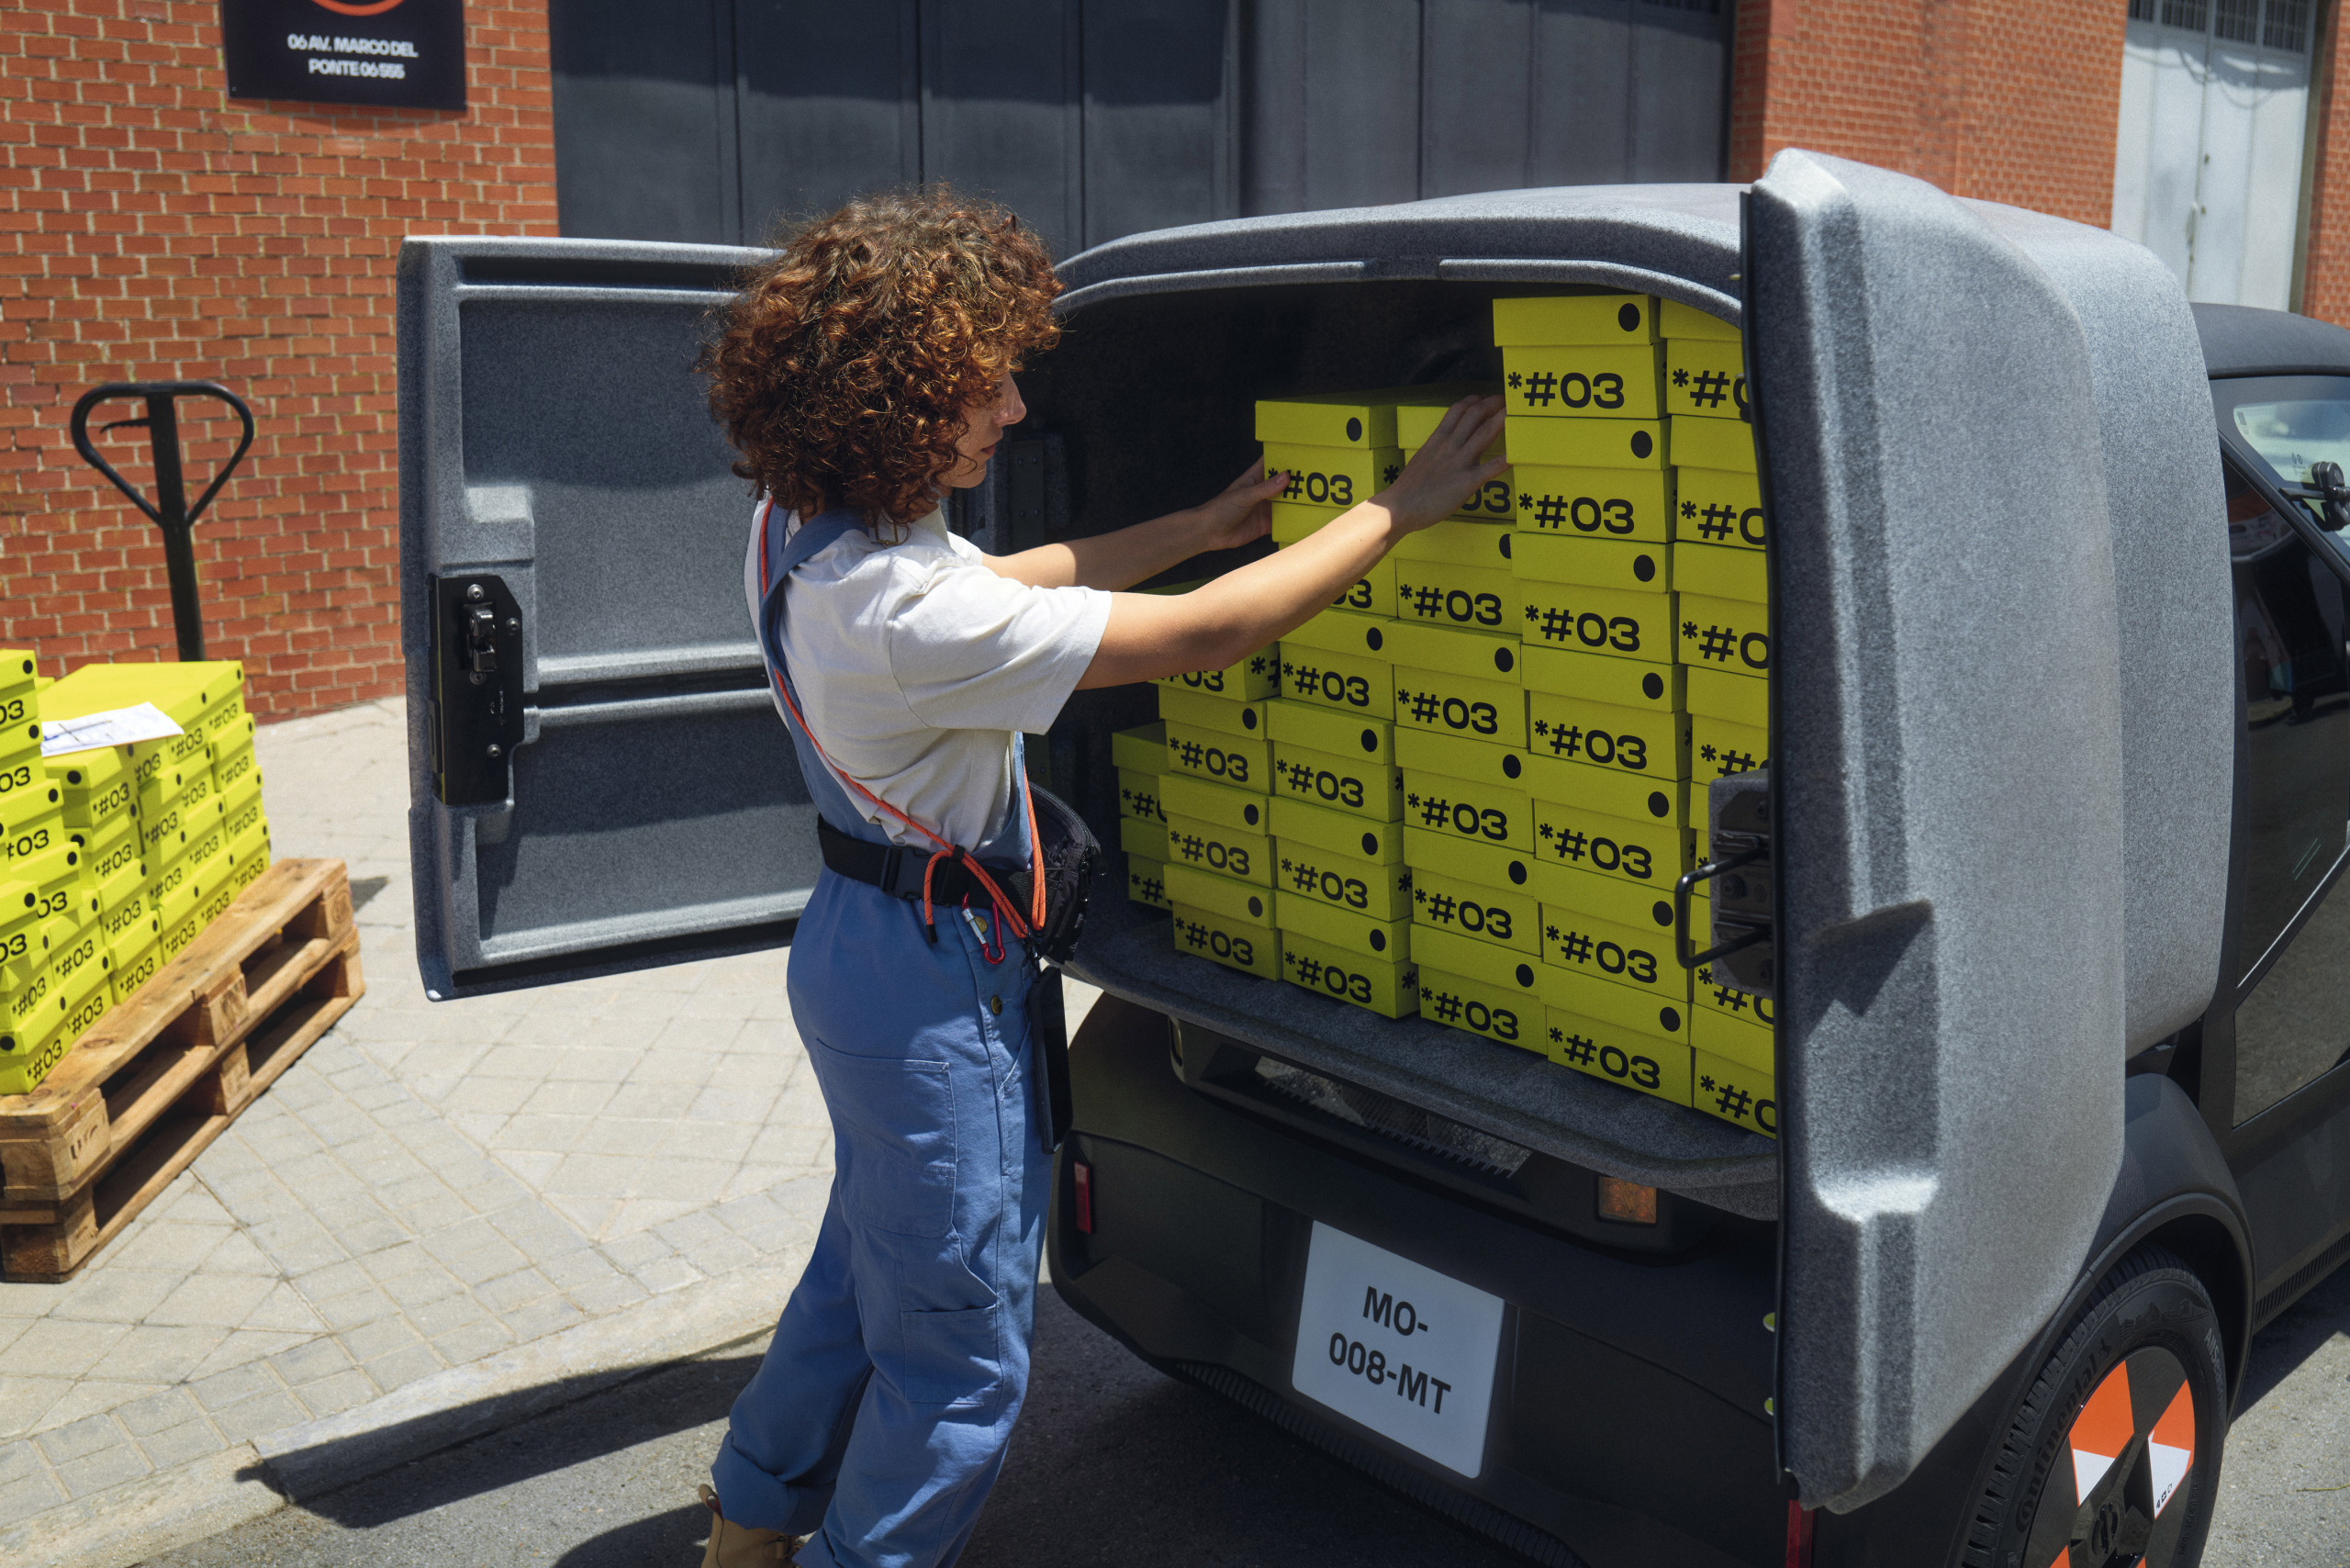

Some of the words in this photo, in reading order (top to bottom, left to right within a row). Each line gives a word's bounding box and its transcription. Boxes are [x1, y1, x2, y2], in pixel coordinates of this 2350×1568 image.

[287, 33, 308, 50] 06
[308, 35, 332, 52] AV.
[333, 37, 390, 56] MARCO
[390, 40, 420, 58] DEL
[308, 58, 360, 77] PONTE
[360, 61, 379, 78] 06
[1681, 501, 1766, 545] #0
[1682, 622, 1769, 669] #0
[0, 766, 30, 793] 03
[135, 753, 162, 784] #03
[184, 781, 207, 808] #03
[1700, 1075, 1775, 1134] #0
[1363, 1285, 1428, 1336] MO-
[1329, 1332, 1451, 1415] 008-MT
